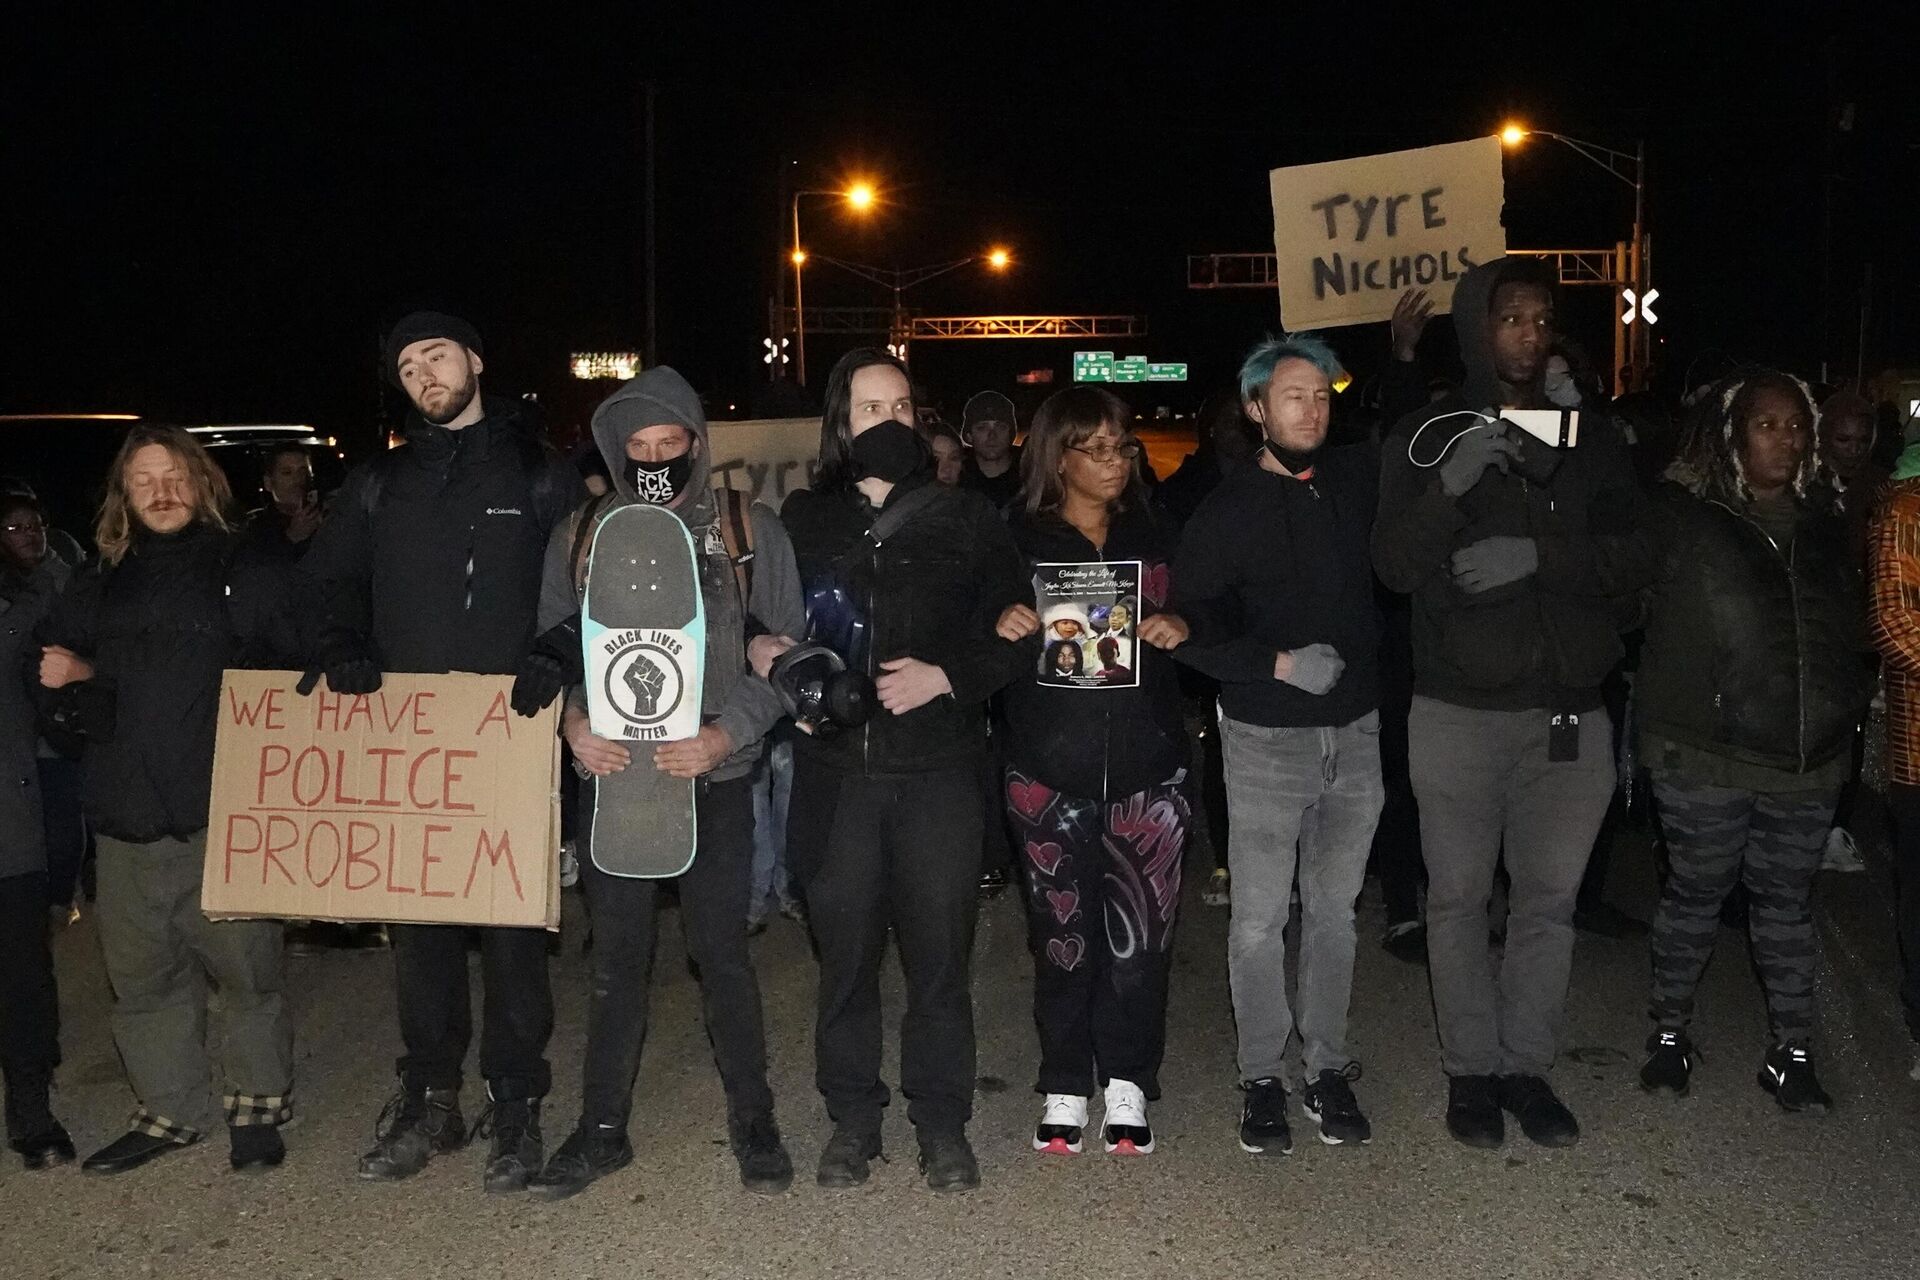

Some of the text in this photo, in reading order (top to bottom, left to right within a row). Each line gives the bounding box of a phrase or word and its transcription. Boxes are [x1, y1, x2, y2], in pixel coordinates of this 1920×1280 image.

[1312, 246, 1479, 300] NICHOLS
[637, 470, 672, 491] FCK
[637, 486, 674, 503] NZS
[493, 507, 522, 515] Columbia
[1058, 567, 1117, 580] Celebrating the Life of
[604, 629, 683, 656] BLACK LIVES
[229, 686, 512, 740] WE HAVE A
[622, 723, 668, 740] MATTER
[257, 744, 478, 812] POLICE
[224, 814, 525, 901] PROBLEM
